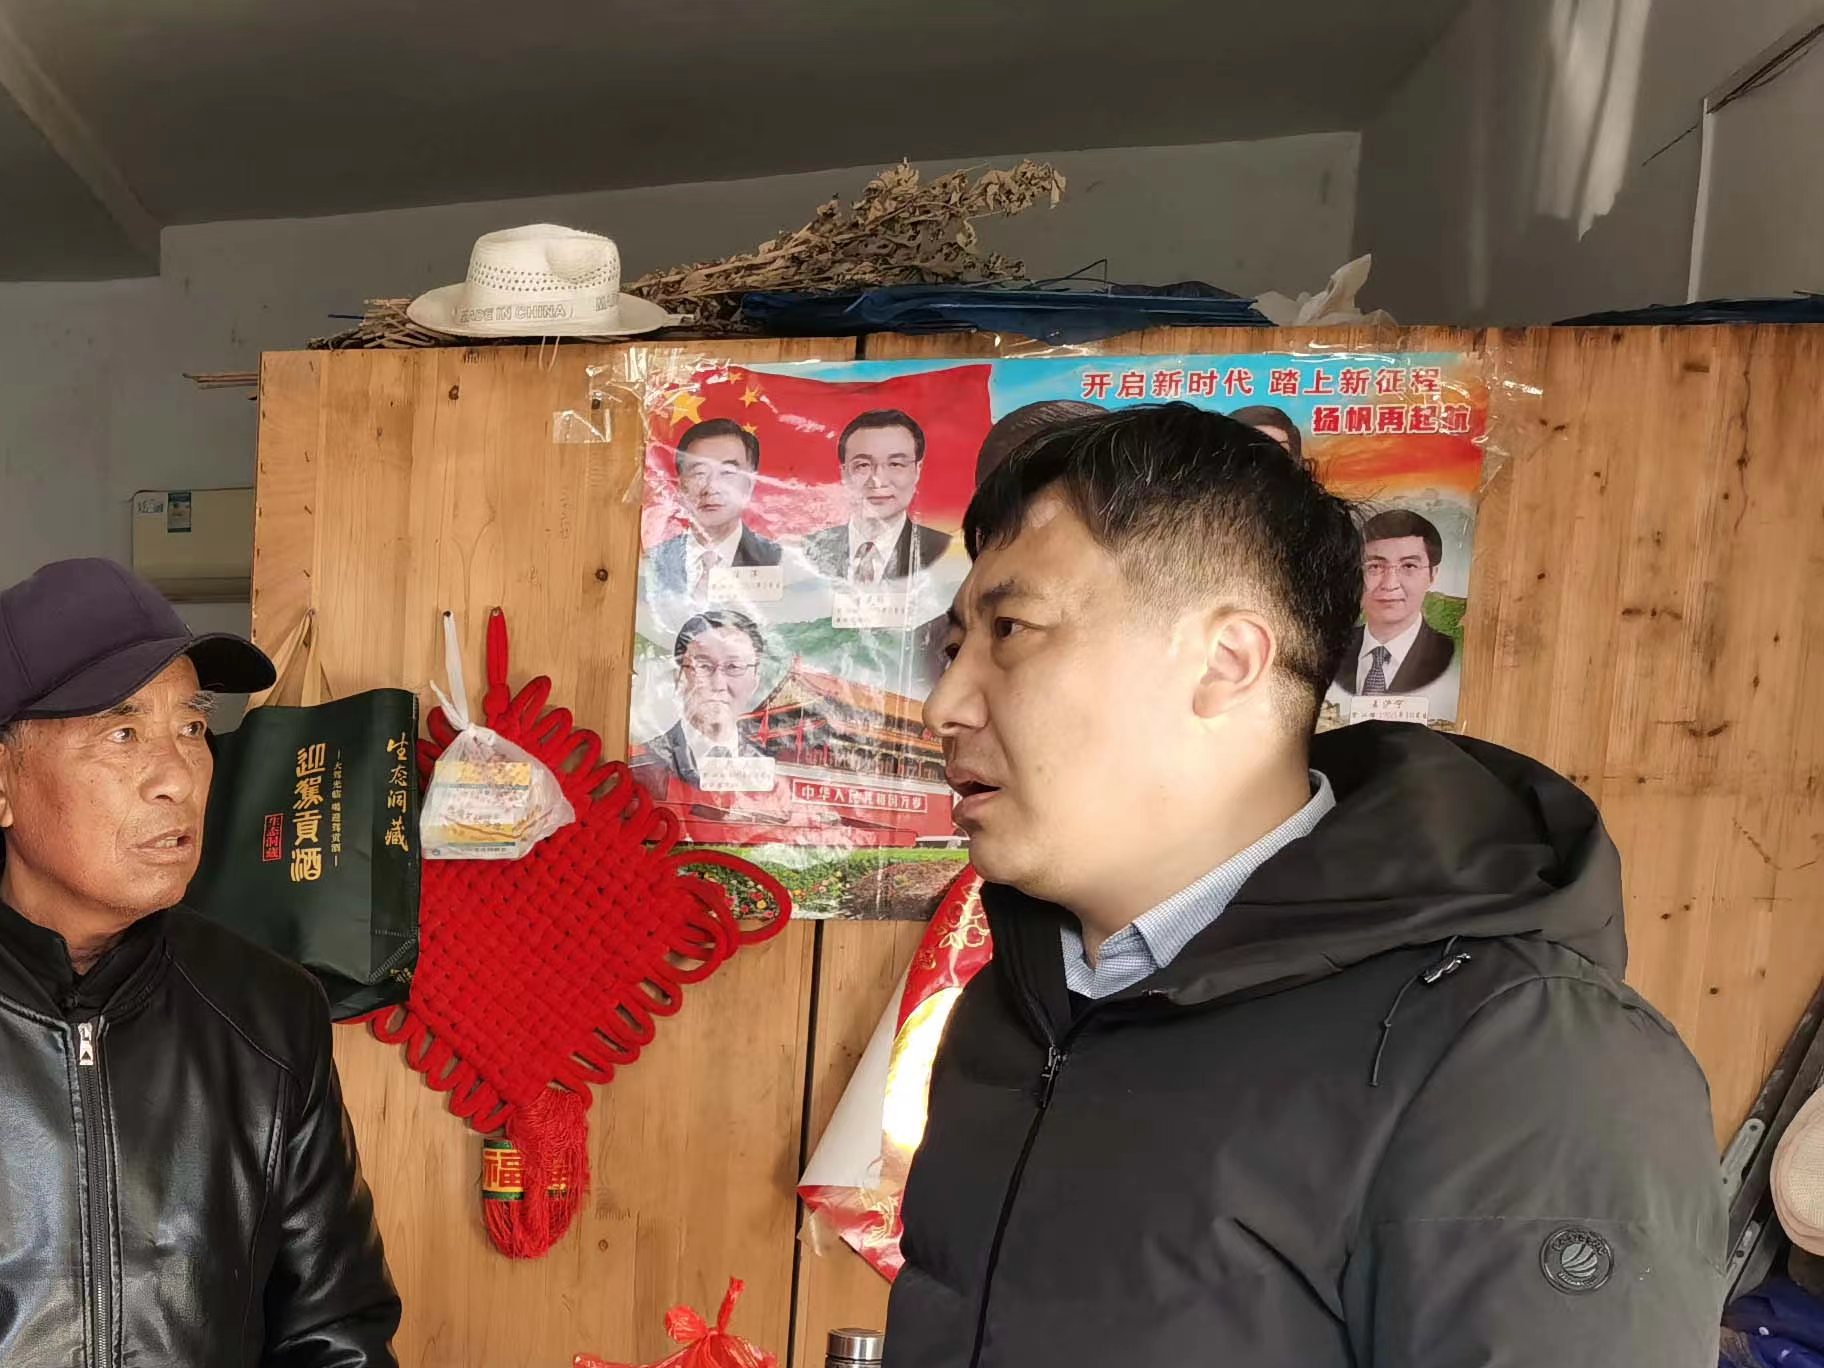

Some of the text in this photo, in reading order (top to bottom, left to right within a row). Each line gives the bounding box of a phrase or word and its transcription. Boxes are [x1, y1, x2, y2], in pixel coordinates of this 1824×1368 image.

[515, 303, 567, 320] CHINA
[1082, 367, 1442, 400] 开启新时代 踏上新征程
[1312, 404, 1472, 435] 扬帆再起航
[385, 731, 409, 852] 生态洞藏
